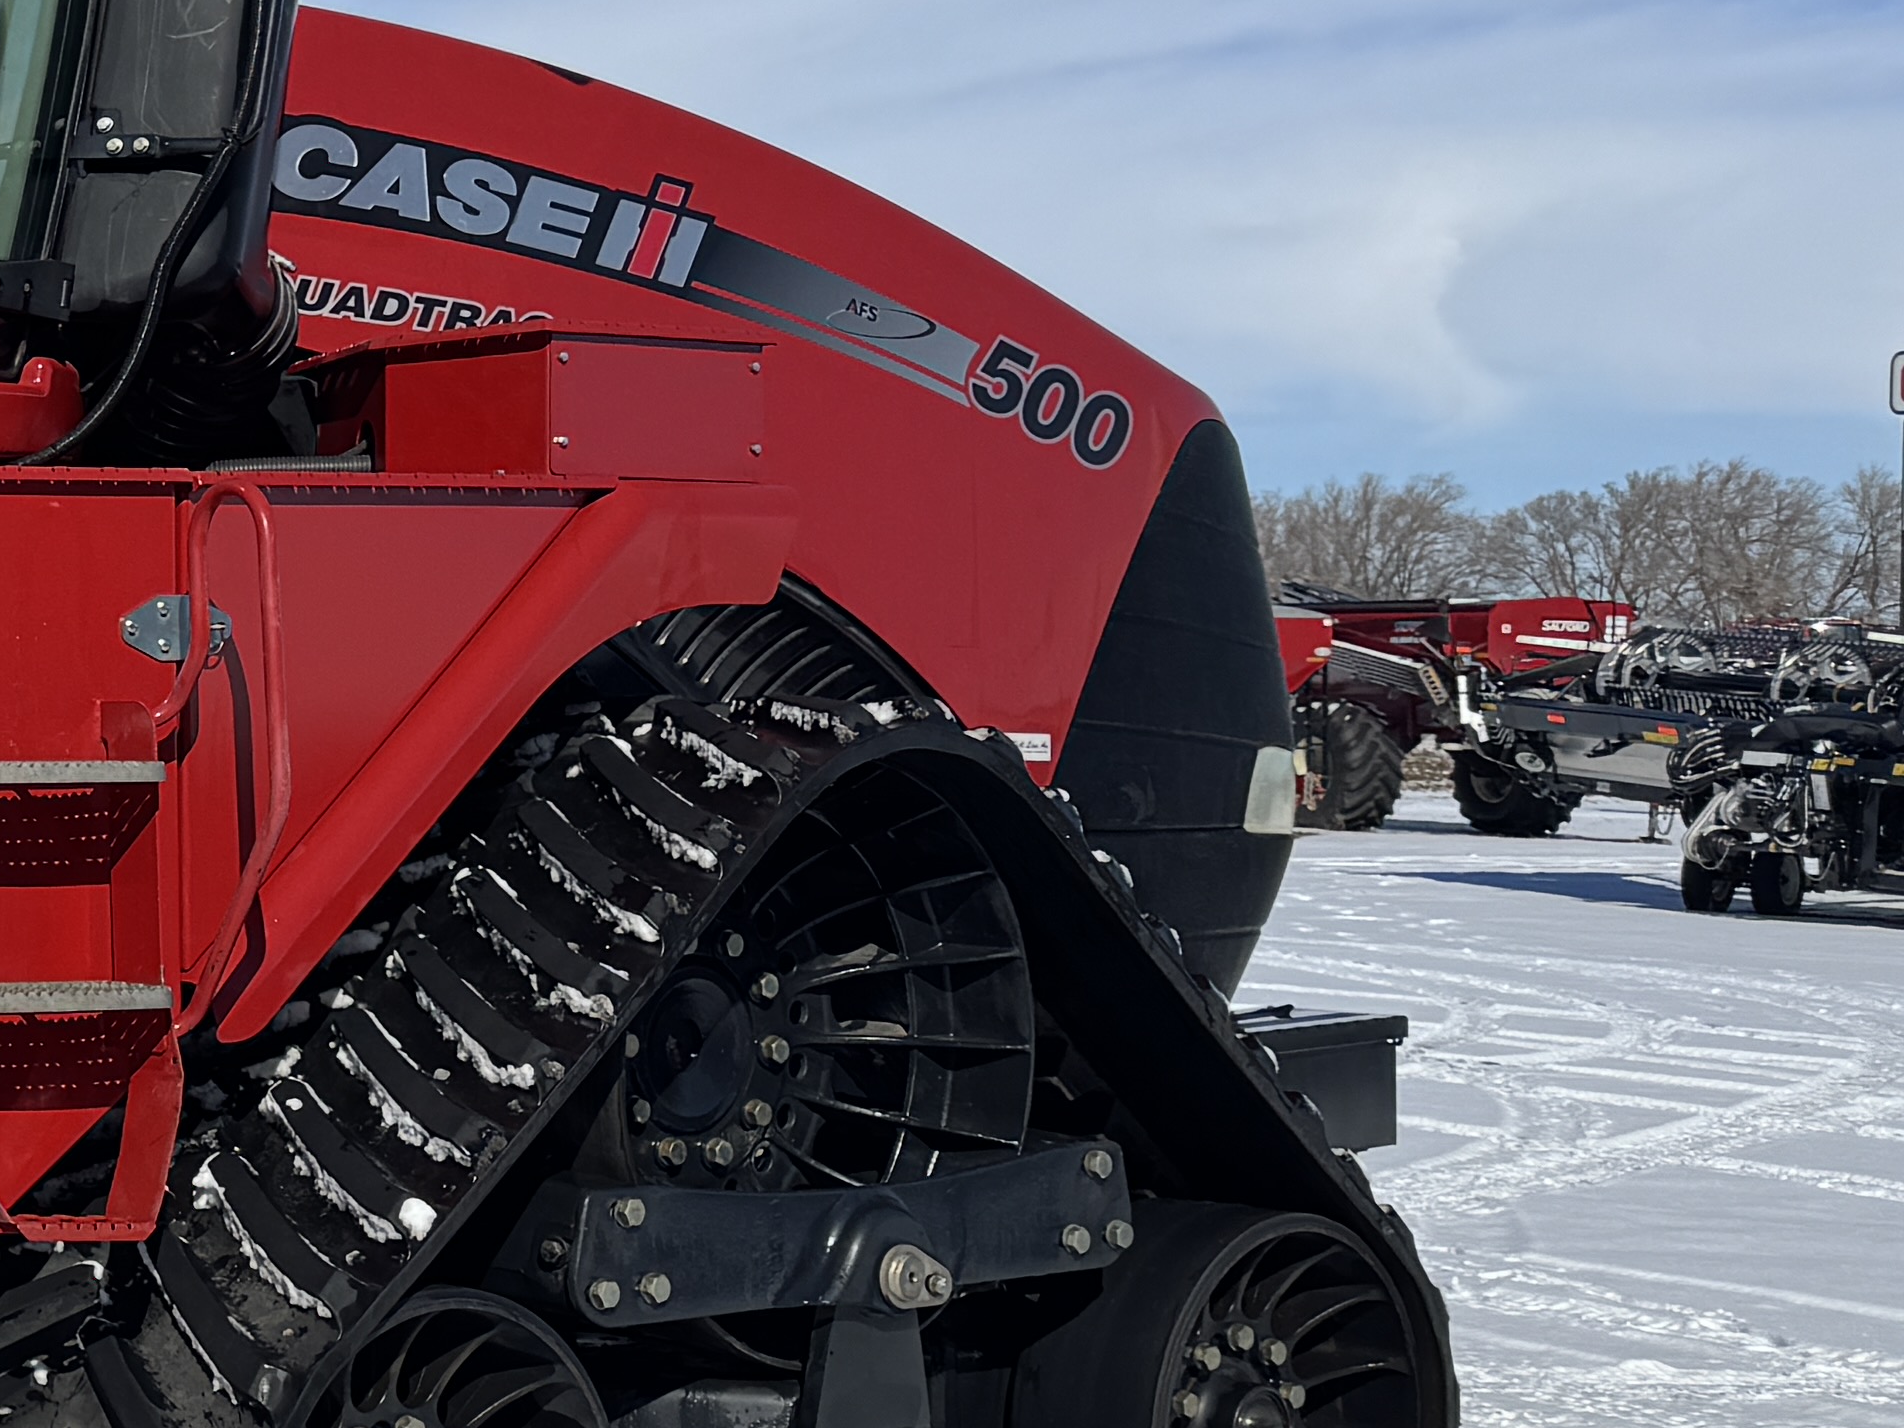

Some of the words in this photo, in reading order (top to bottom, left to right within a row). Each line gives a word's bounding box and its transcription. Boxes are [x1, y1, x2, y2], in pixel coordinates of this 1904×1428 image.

[272, 124, 599, 259] CASE
[286, 274, 553, 331] UADTRA
[845, 298, 880, 322] AFS
[969, 334, 1133, 470] 500
